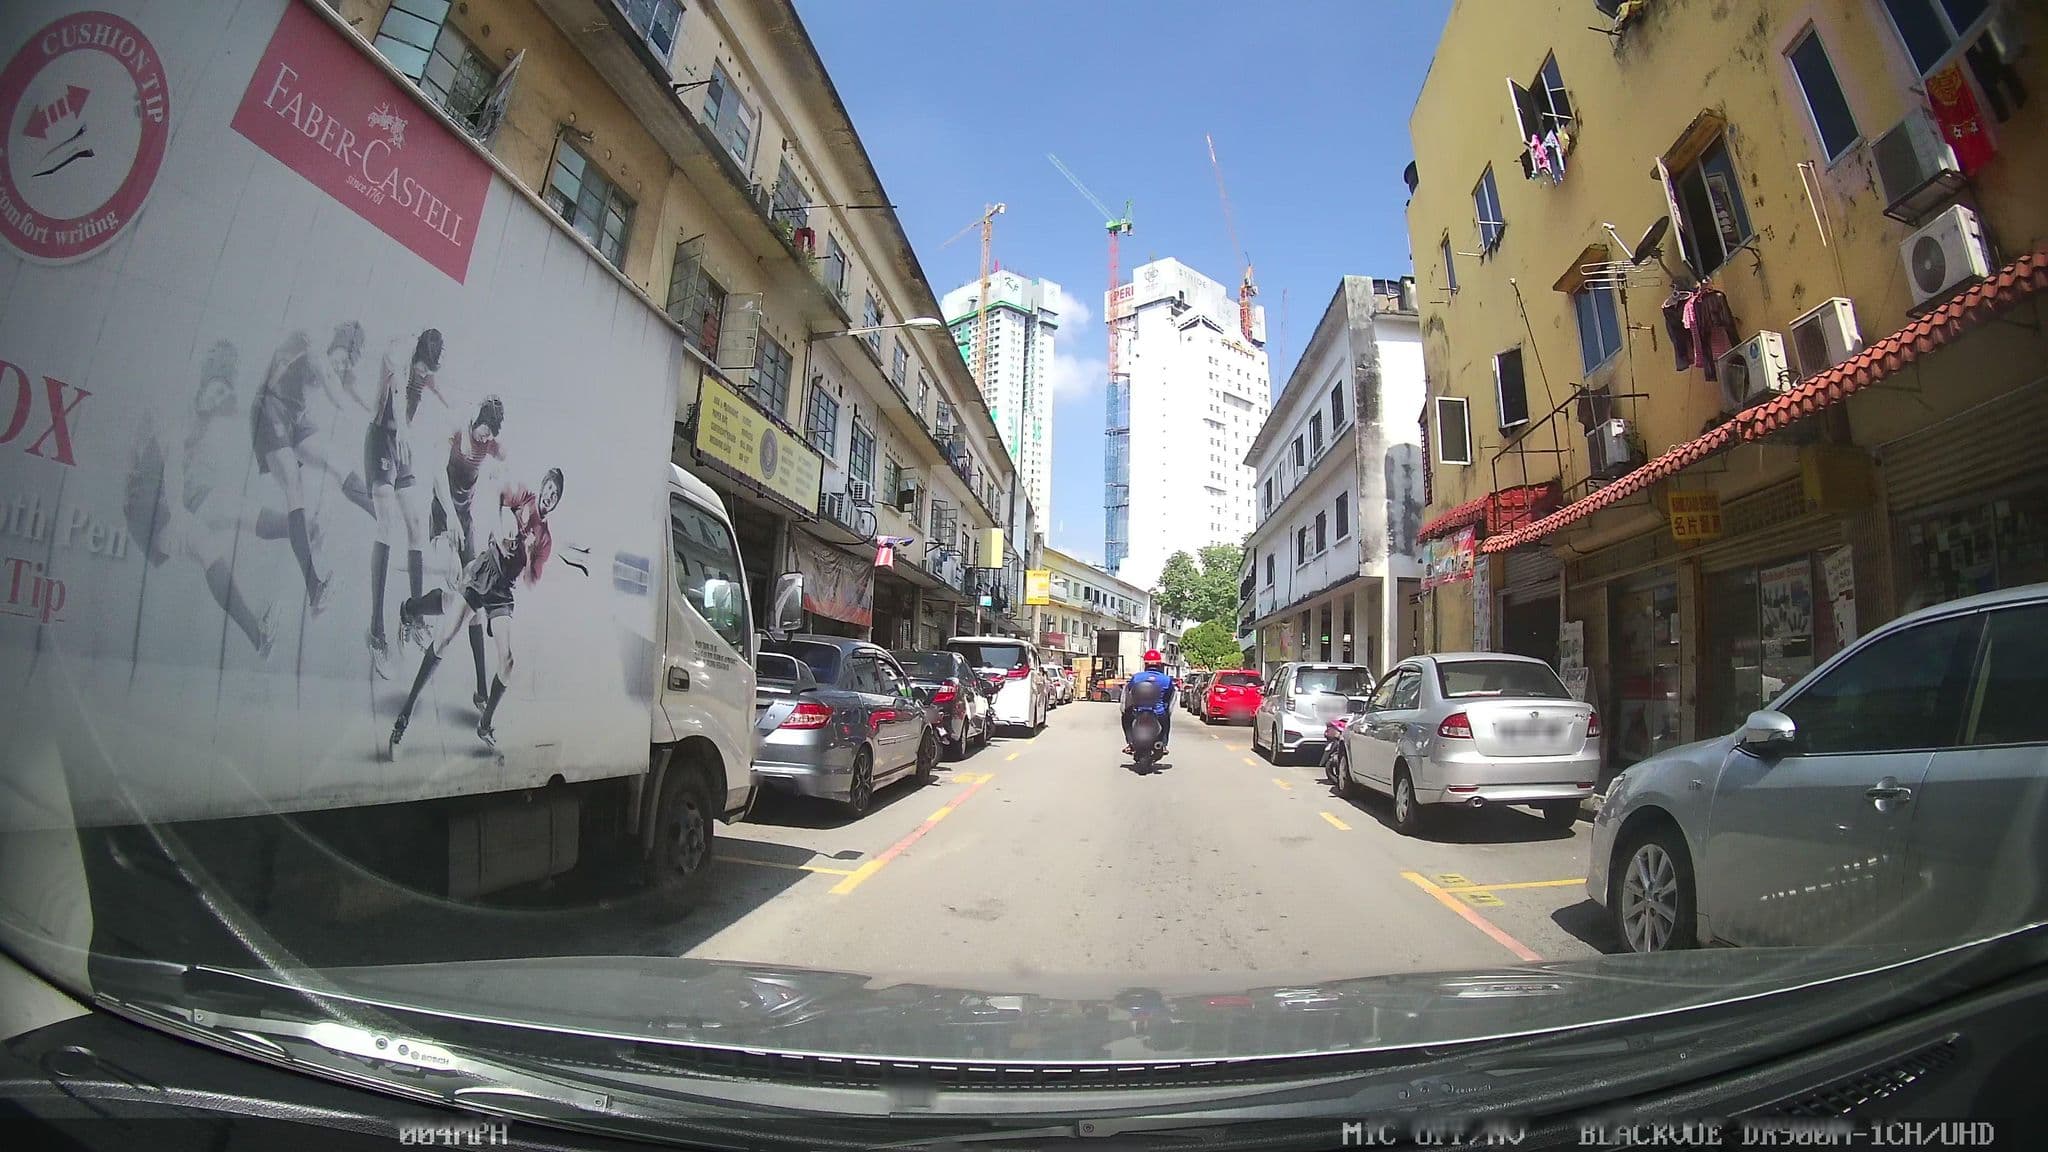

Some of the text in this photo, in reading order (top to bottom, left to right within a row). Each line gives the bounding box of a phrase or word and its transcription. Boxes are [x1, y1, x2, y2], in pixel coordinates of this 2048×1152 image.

[43, 23, 164, 124] CUSHION TIP
[345, 174, 367, 194] since
[55, 210, 118, 246] writing
[60, 503, 127, 560] Pen
[5, 557, 66, 624] Tip
